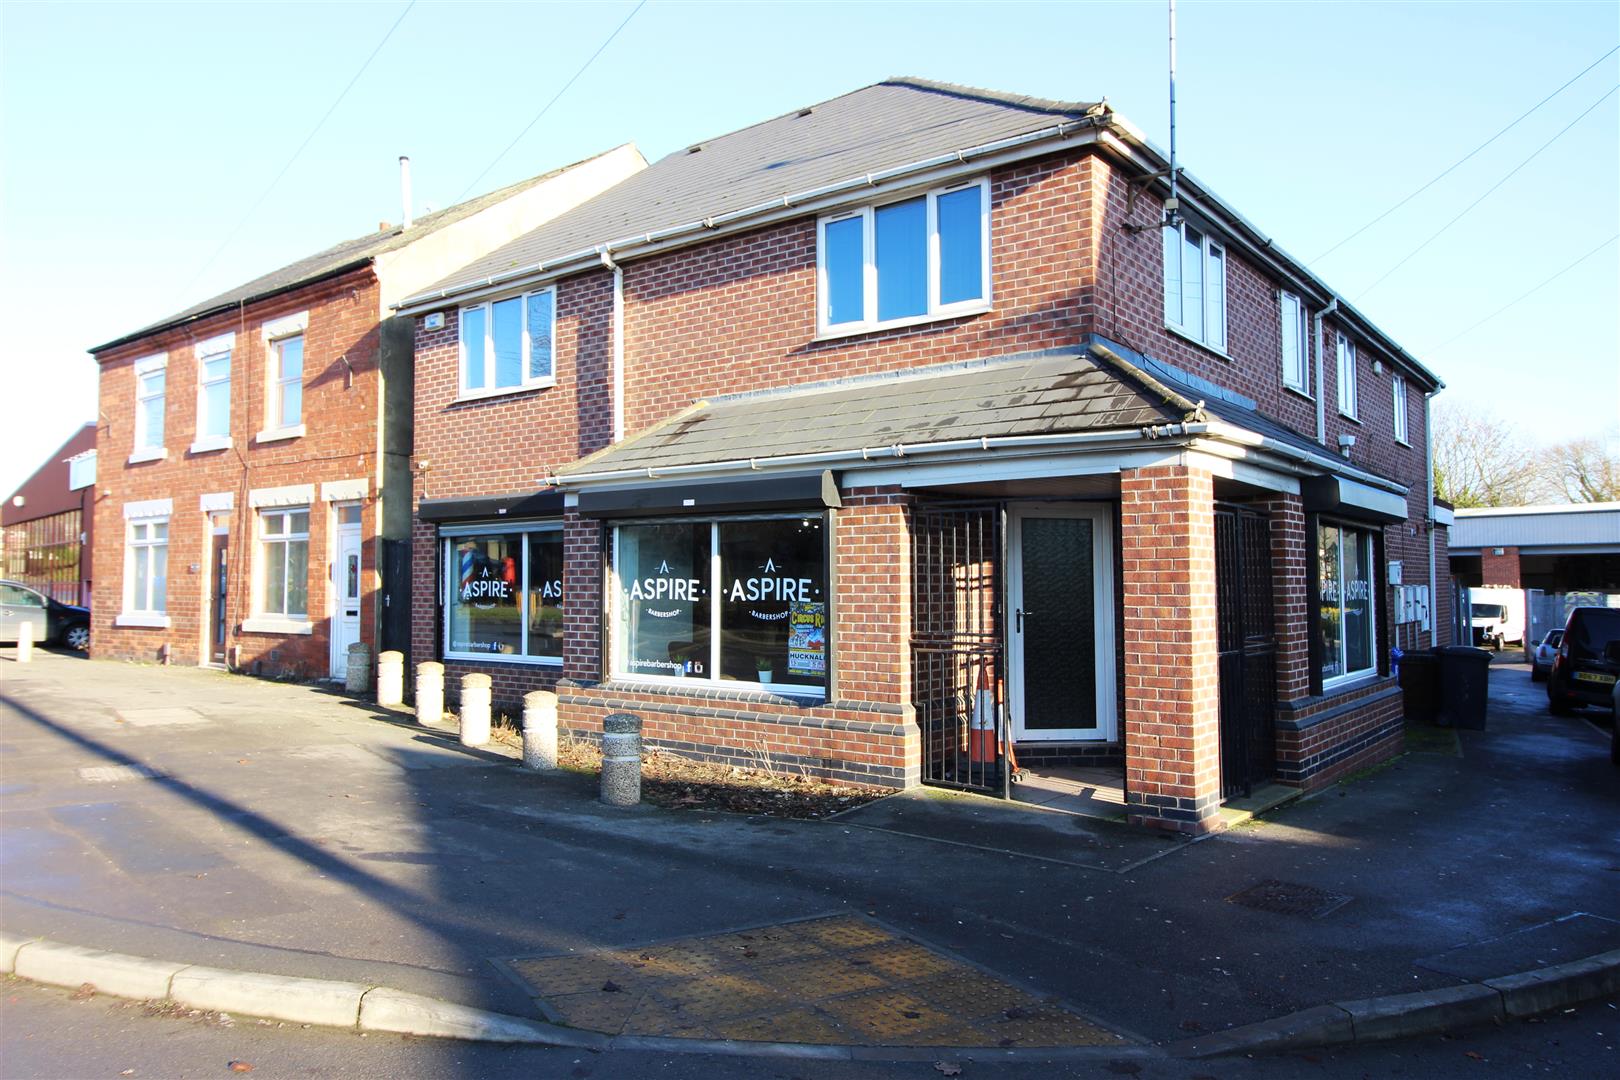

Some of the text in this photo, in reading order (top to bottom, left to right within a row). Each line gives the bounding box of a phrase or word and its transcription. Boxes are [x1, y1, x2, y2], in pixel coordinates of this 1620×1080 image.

[463, 581, 509, 598] ASPIRE
[630, 578, 700, 602] ASPIRE
[730, 577, 812, 602] ASPIRE
[1346, 580, 1368, 601] ASPIRE
[648, 608, 680, 618] BARBERSHOP
[751, 610, 788, 621] BARBERSHOP
[790, 652, 825, 662] HUCKNAL
